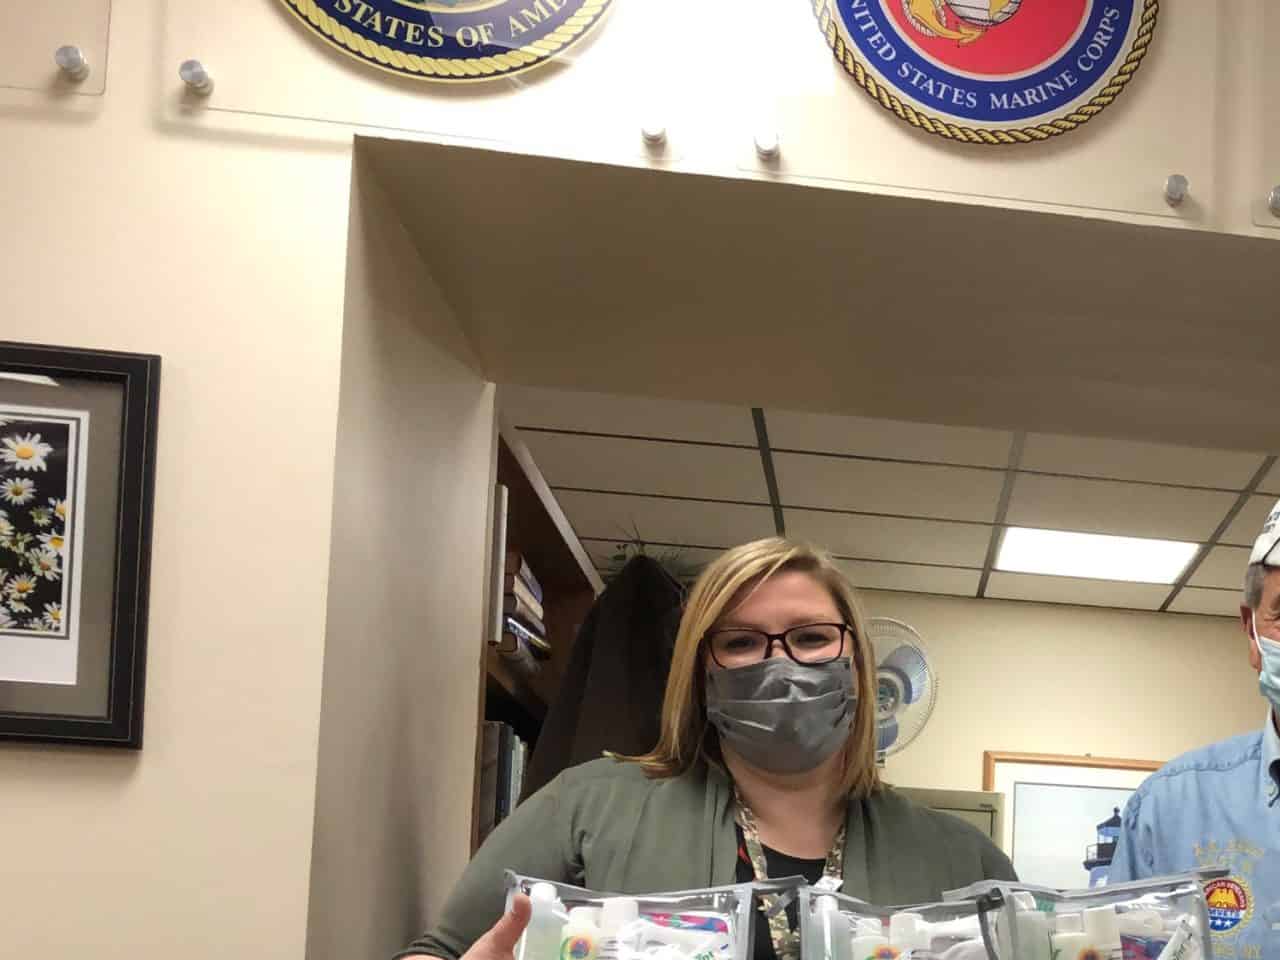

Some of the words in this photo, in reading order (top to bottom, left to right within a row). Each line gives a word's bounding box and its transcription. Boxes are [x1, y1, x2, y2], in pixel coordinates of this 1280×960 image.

[333, 0, 445, 48] STATES
[456, 22, 495, 49] OF
[897, 61, 978, 109] STATES
[989, 72, 1078, 111] MARINE
[1076, 6, 1121, 72] CORPS
